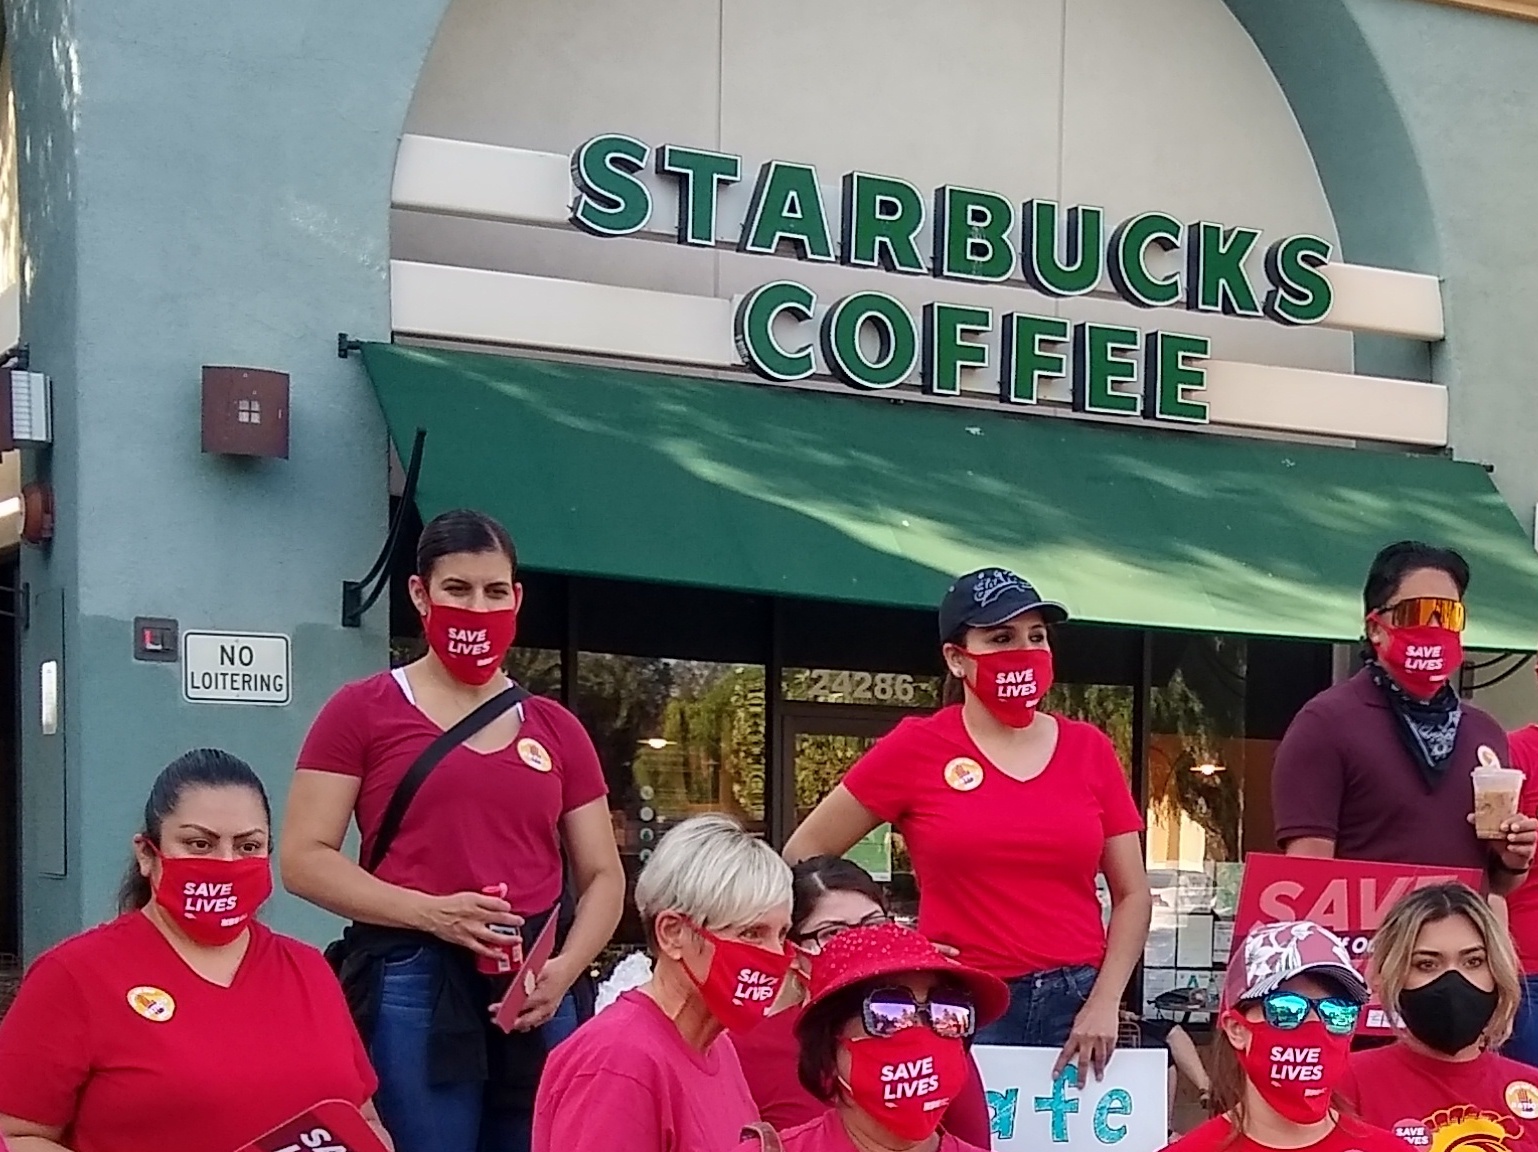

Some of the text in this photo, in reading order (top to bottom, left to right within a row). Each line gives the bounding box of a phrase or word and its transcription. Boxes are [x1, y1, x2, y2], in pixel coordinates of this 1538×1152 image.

[569, 132, 1335, 325] STARBUCKS
[735, 280, 1211, 424] COFFEE
[447, 627, 488, 643] SAVE
[219, 644, 254, 667] NO
[448, 640, 492, 656] LIVES
[1405, 645, 1442, 658] SAVE
[1404, 656, 1444, 671] LIVES
[190, 671, 284, 693] LOITERING
[808, 668, 915, 701] 24286
[995, 668, 1034, 685] SAVE
[997, 681, 1037, 698] LIVES
[184, 881, 233, 897] SAVE
[184, 896, 238, 912] LIVES
[1250, 874, 1460, 932] SAV
[1269, 1046, 1322, 1064] SAVE
[880, 1056, 934, 1082] SAVE
[1270, 1063, 1324, 1082] LIVES
[883, 1075, 940, 1101] LIVES
[986, 1063, 1133, 1144] afe
[1395, 1126, 1425, 1138] SAVE
[1402, 1135, 1430, 1146] VES
